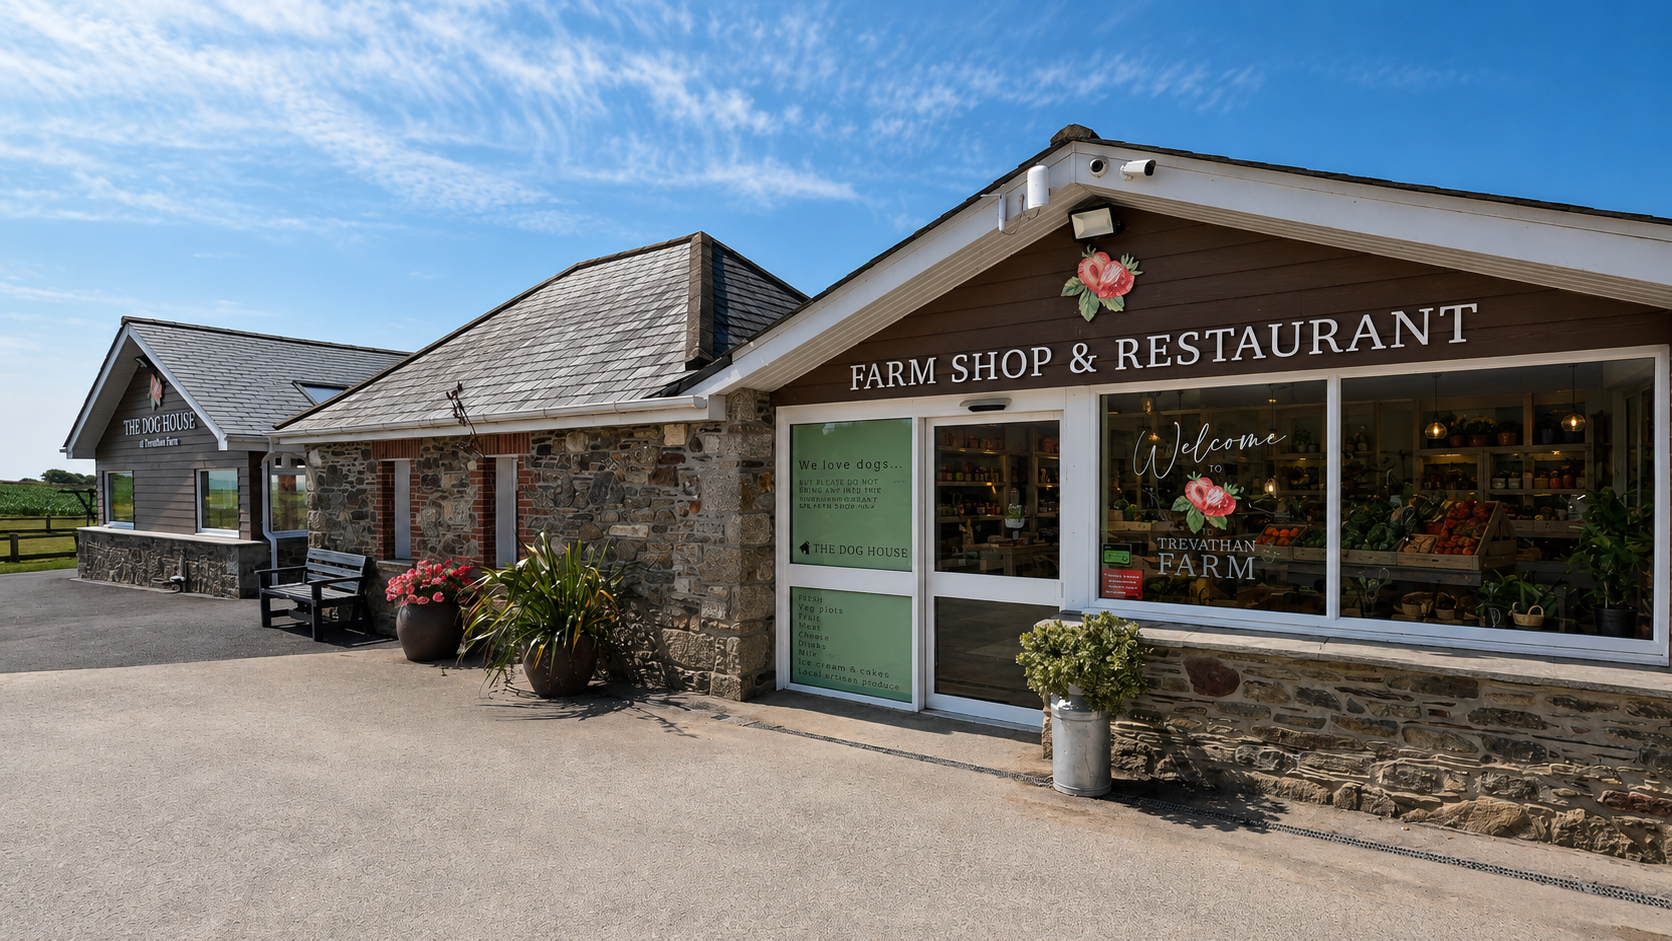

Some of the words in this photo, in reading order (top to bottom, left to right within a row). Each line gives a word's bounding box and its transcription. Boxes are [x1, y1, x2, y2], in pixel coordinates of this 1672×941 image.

[850, 356, 937, 391] FARM
[951, 346, 1052, 384] SHOP
[1070, 342, 1097, 374] &
[1115, 303, 1478, 371] RESTAURANT
[123, 418, 140, 436] THE
[142, 415, 161, 434] DOG
[162, 411, 196, 432] HOUSE
[1132, 421, 1287, 480] Welcome
[799, 460, 817, 470] We
[822, 460, 851, 470] love
[856, 459, 903, 472] dogs...
[1208, 464, 1223, 474] TO
[862, 478, 879, 486] NOT
[813, 543, 836, 554] THE
[839, 545, 863, 556] DOG
[867, 546, 908, 558] HOUSE
[1157, 537, 1256, 552] TREVATHAN
[1157, 553, 1255, 580] FARM
[798, 604, 815, 613] Veg
[819, 606, 844, 615] plots
[798, 658, 812, 666] Ice
[816, 661, 846, 672] cream
[859, 668, 890, 679] cakes
[798, 668, 822, 678] Local
[862, 679, 900, 691] produce
